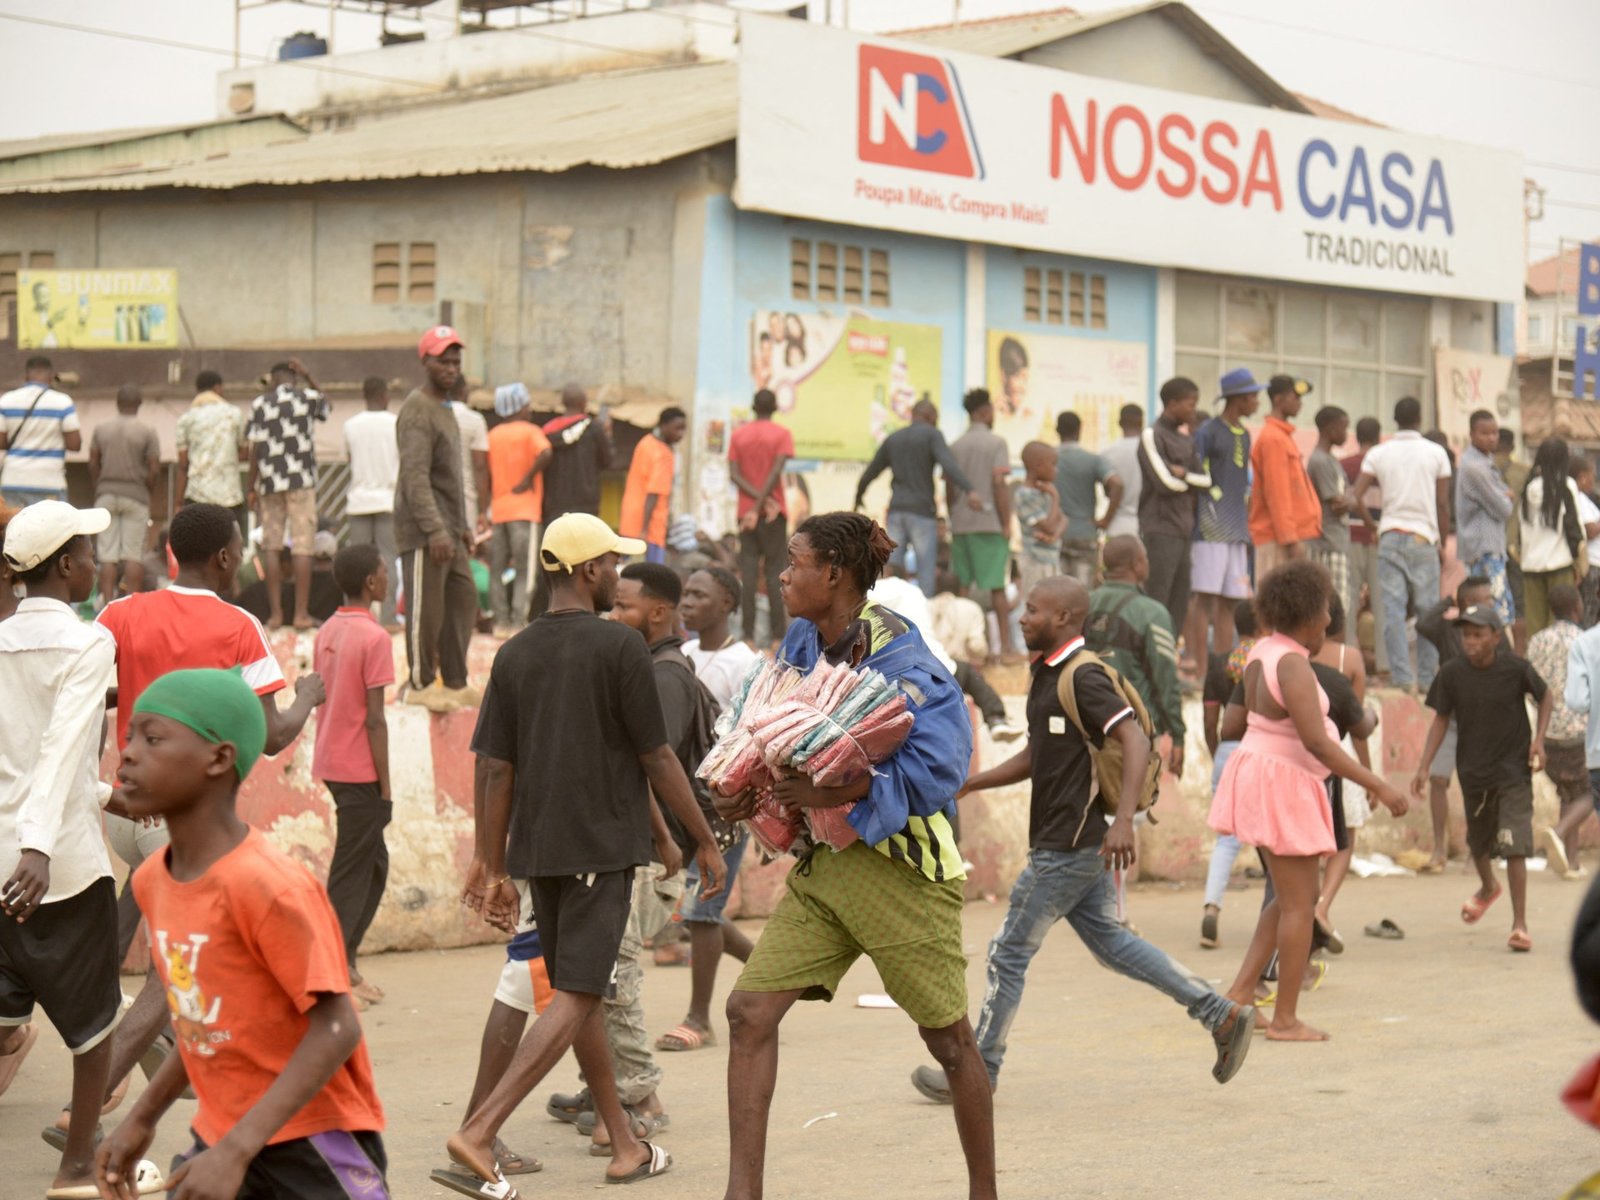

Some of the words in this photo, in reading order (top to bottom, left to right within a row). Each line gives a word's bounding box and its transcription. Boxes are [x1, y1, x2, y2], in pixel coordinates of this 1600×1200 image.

[868, 66, 949, 154] NC
[1050, 92, 1284, 213] NOSSA
[1297, 138, 1455, 237] CASA
[854, 178, 904, 206] Poupa
[908, 186, 947, 213] Mais,
[950, 192, 1008, 221] Compra
[1010, 201, 1050, 226] Mais!
[1303, 231, 1456, 277] TRADICIONAL
